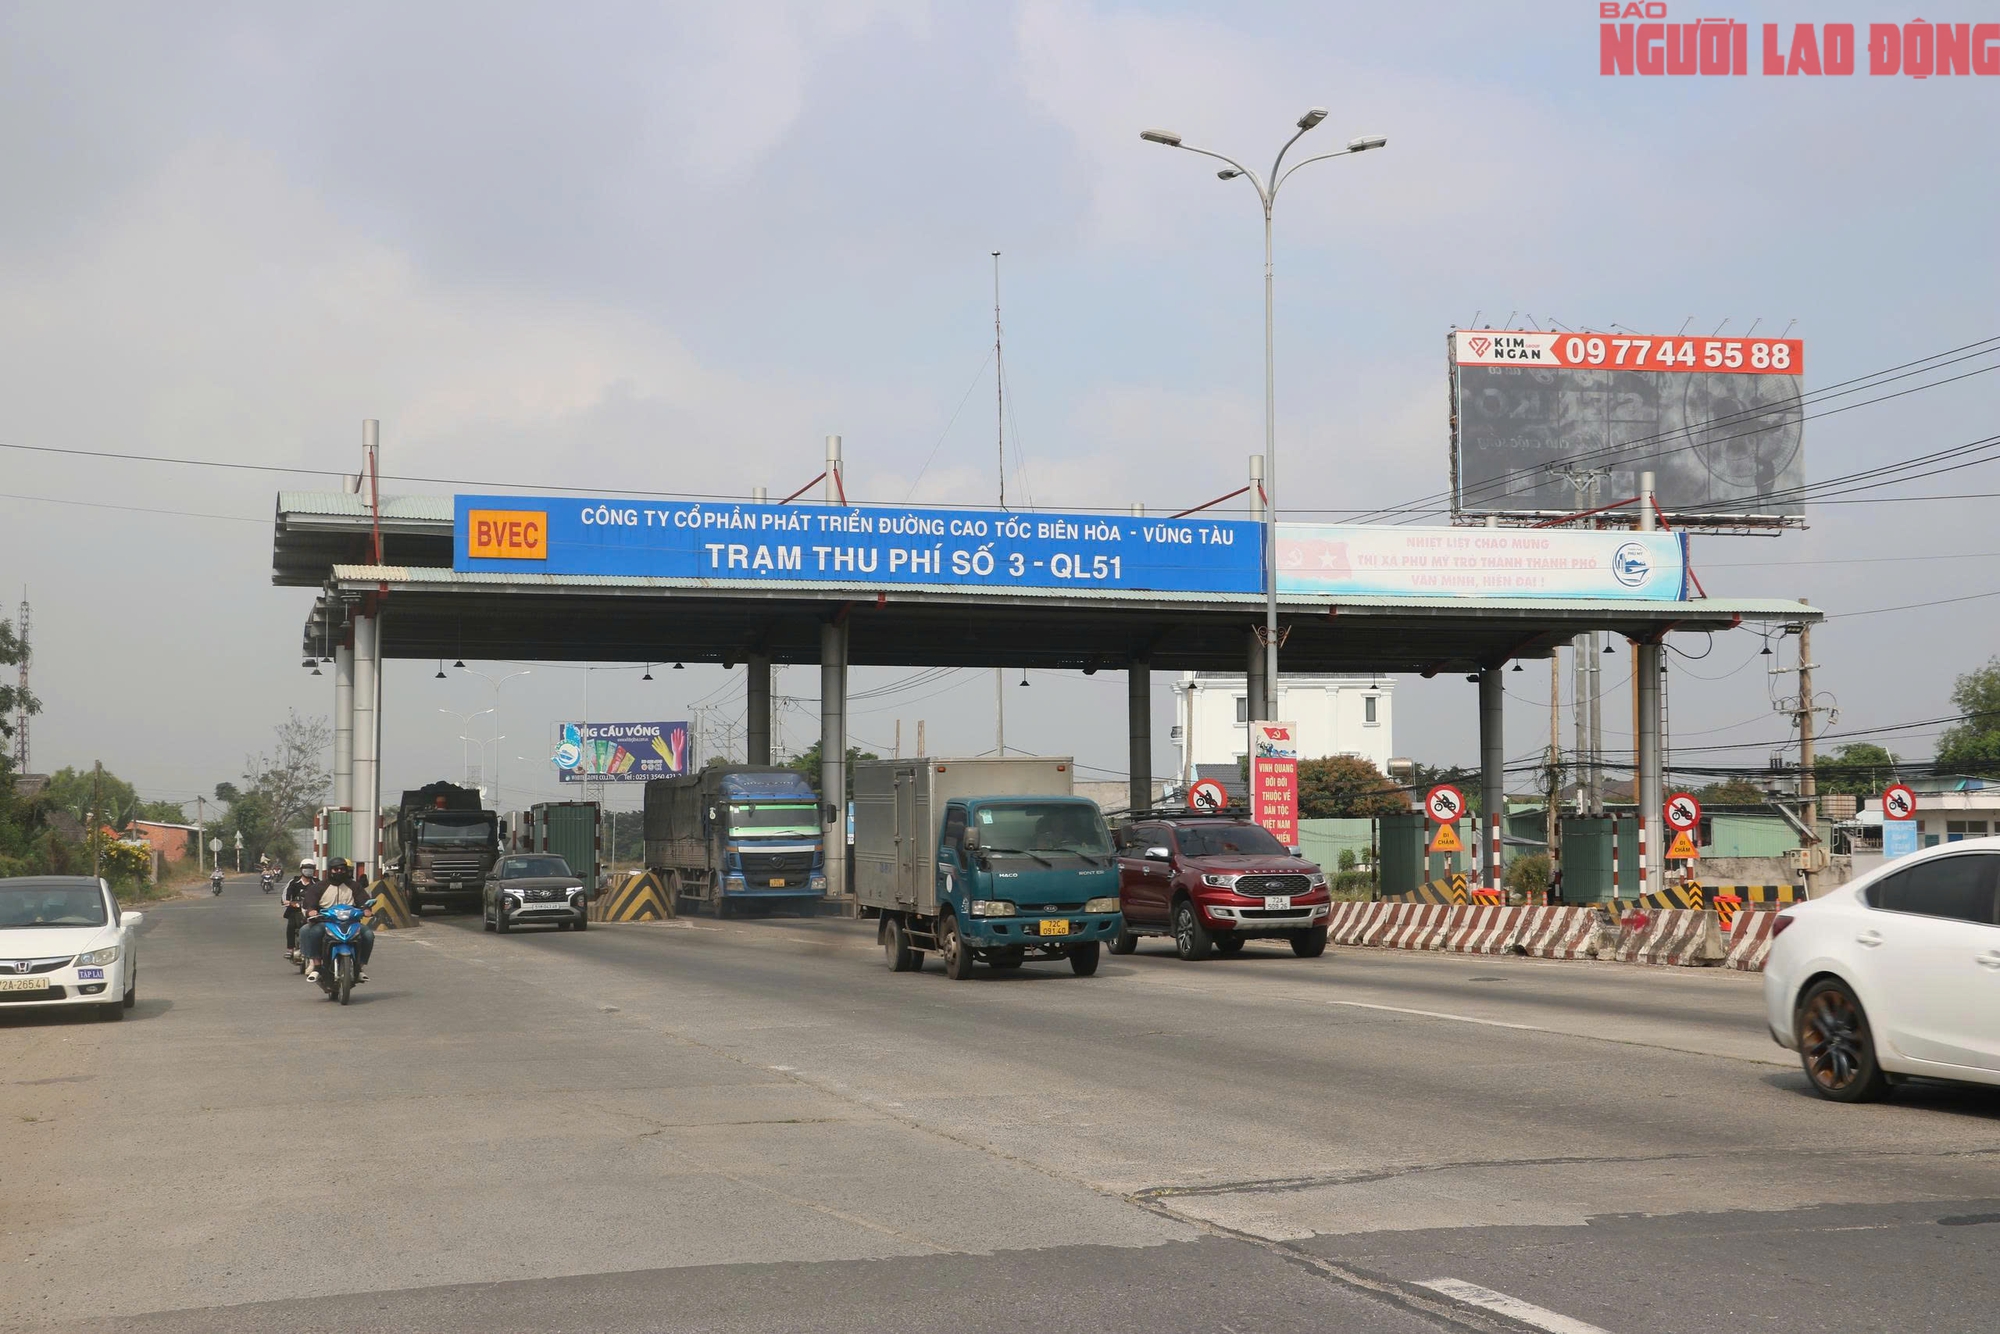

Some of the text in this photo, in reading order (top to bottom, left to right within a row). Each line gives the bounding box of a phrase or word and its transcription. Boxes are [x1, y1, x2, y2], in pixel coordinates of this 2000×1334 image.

[1494, 338, 1524, 348] KIM
[1494, 349, 1541, 359] NGAN
[1566, 337, 1791, 370] 09 77 44 55 88
[581, 504, 638, 526] CÔNG
[644, 510, 670, 527] TY
[674, 503, 701, 528] CỔ
[704, 505, 756, 529] PHẦN
[761, 510, 811, 531] PHÁT
[817, 508, 873, 533] TRIỂN
[879, 513, 945, 536] ĐƯỜNG
[950, 520, 988, 537] CAO
[995, 515, 1031, 539] TỐC
[1038, 519, 1078, 540] BIÊN
[1084, 520, 1121, 541] HÒA
[1143, 523, 1193, 544] VŨNG
[1199, 525, 1234, 546] TÀU
[477, 521, 539, 549] BVEC
[705, 543, 801, 575] TRẠM
[812, 546, 878, 573] THU
[889, 542, 944, 574] PHÍ
[952, 542, 995, 576] SỐ
[1009, 553, 1025, 577] 3
[1051, 553, 1121, 579] QL51
[1258, 763, 1294, 774] VINH QUANG
[1262, 817, 1290, 831] VIỆT NAM
[1048, 920, 1061, 928] 72C
